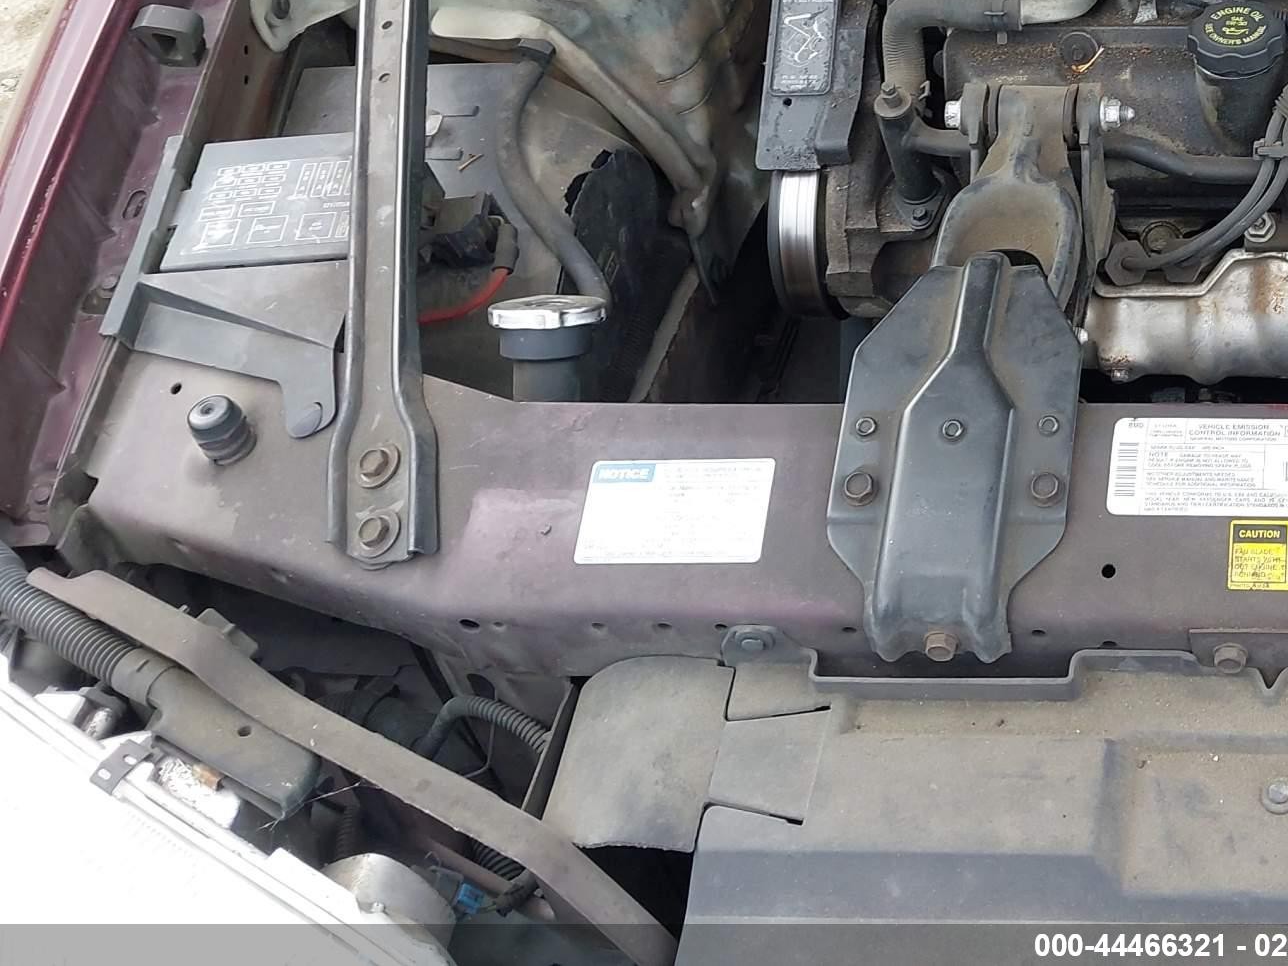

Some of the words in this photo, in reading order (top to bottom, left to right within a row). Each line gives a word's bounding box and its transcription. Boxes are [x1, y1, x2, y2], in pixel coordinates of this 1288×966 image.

[1210, 7, 1252, 20] ENGINE
[1251, 10, 1265, 22] OIL
[598, 468, 650, 480] NOTICE
[1239, 529, 1281, 539] CAUTION
